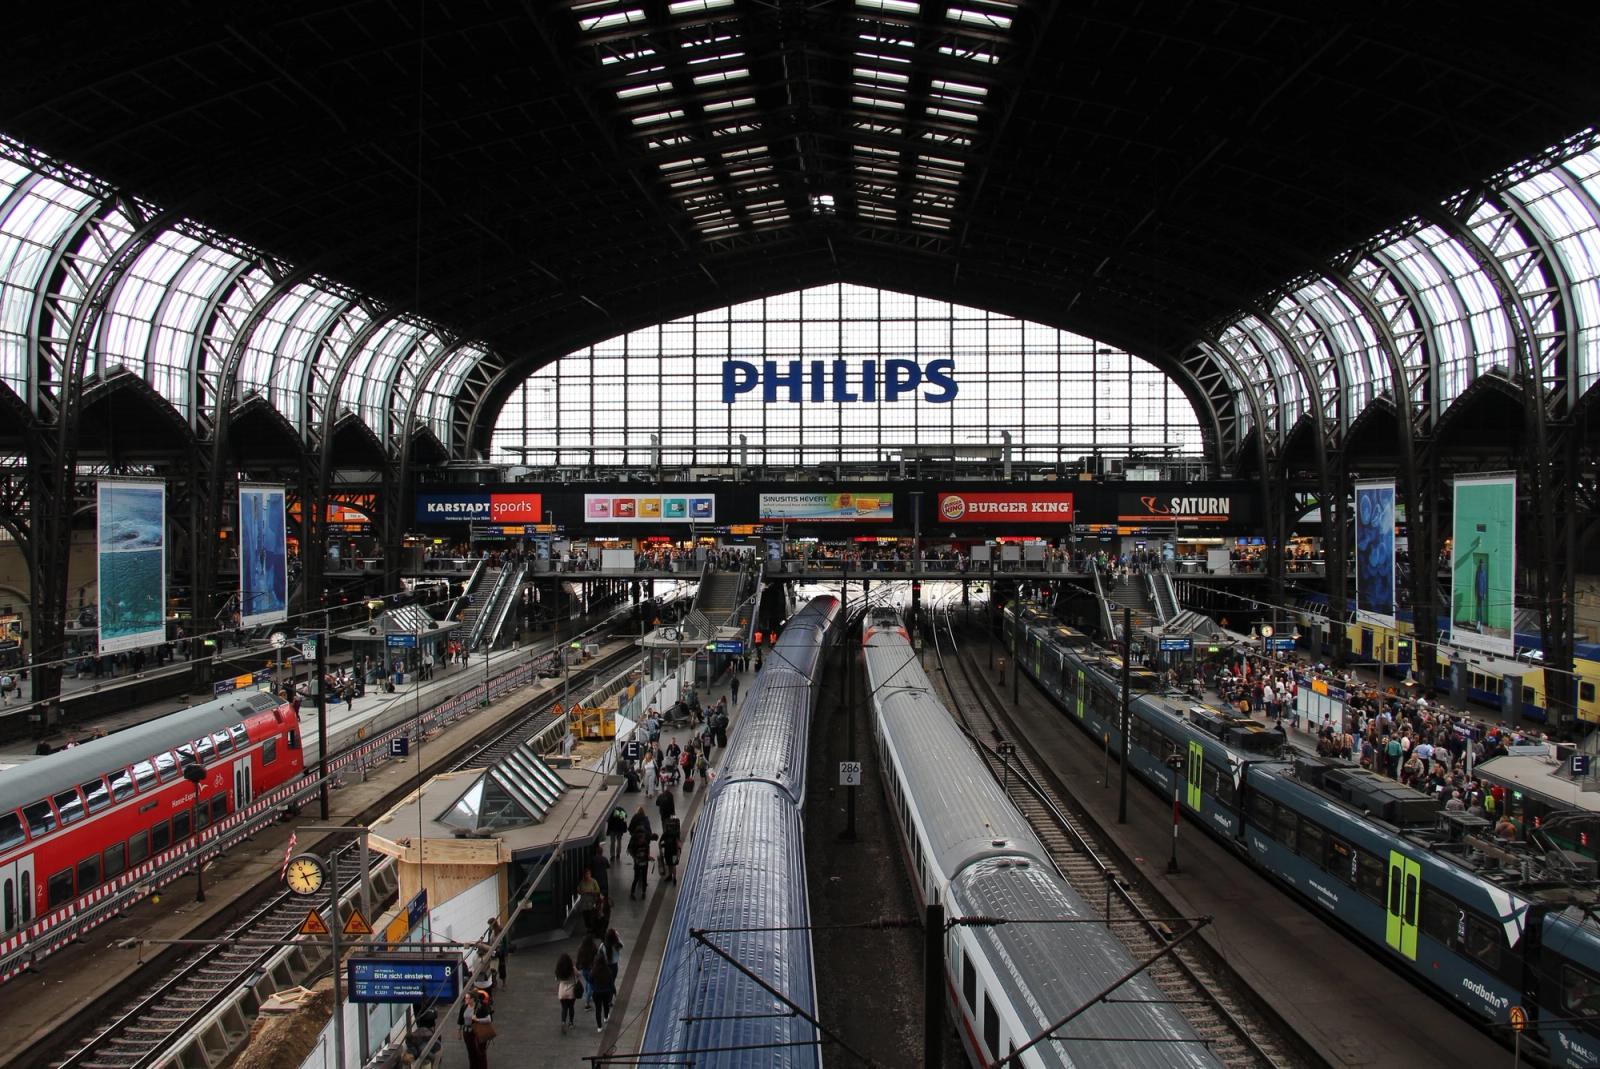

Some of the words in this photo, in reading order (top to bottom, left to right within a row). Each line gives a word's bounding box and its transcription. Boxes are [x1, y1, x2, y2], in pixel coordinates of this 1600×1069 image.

[723, 359, 958, 403] PHILIPS
[763, 495, 798, 503] SINUSITIS
[799, 495, 827, 503] HEVERT
[427, 502, 490, 513] KARSTADT
[494, 501, 532, 514] sports
[968, 502, 1028, 513] BURGER
[1031, 502, 1069, 513] KING
[1170, 497, 1231, 515] SATURN
[393, 739, 401, 752] E
[627, 742, 637, 756] E
[841, 763, 859, 773] 286
[1572, 756, 1582, 771] E
[847, 774, 853, 783] 6
[37, 884, 43, 896] 2
[444, 966, 451, 977] 8
[1462, 977, 1501, 1009] nordbahn
